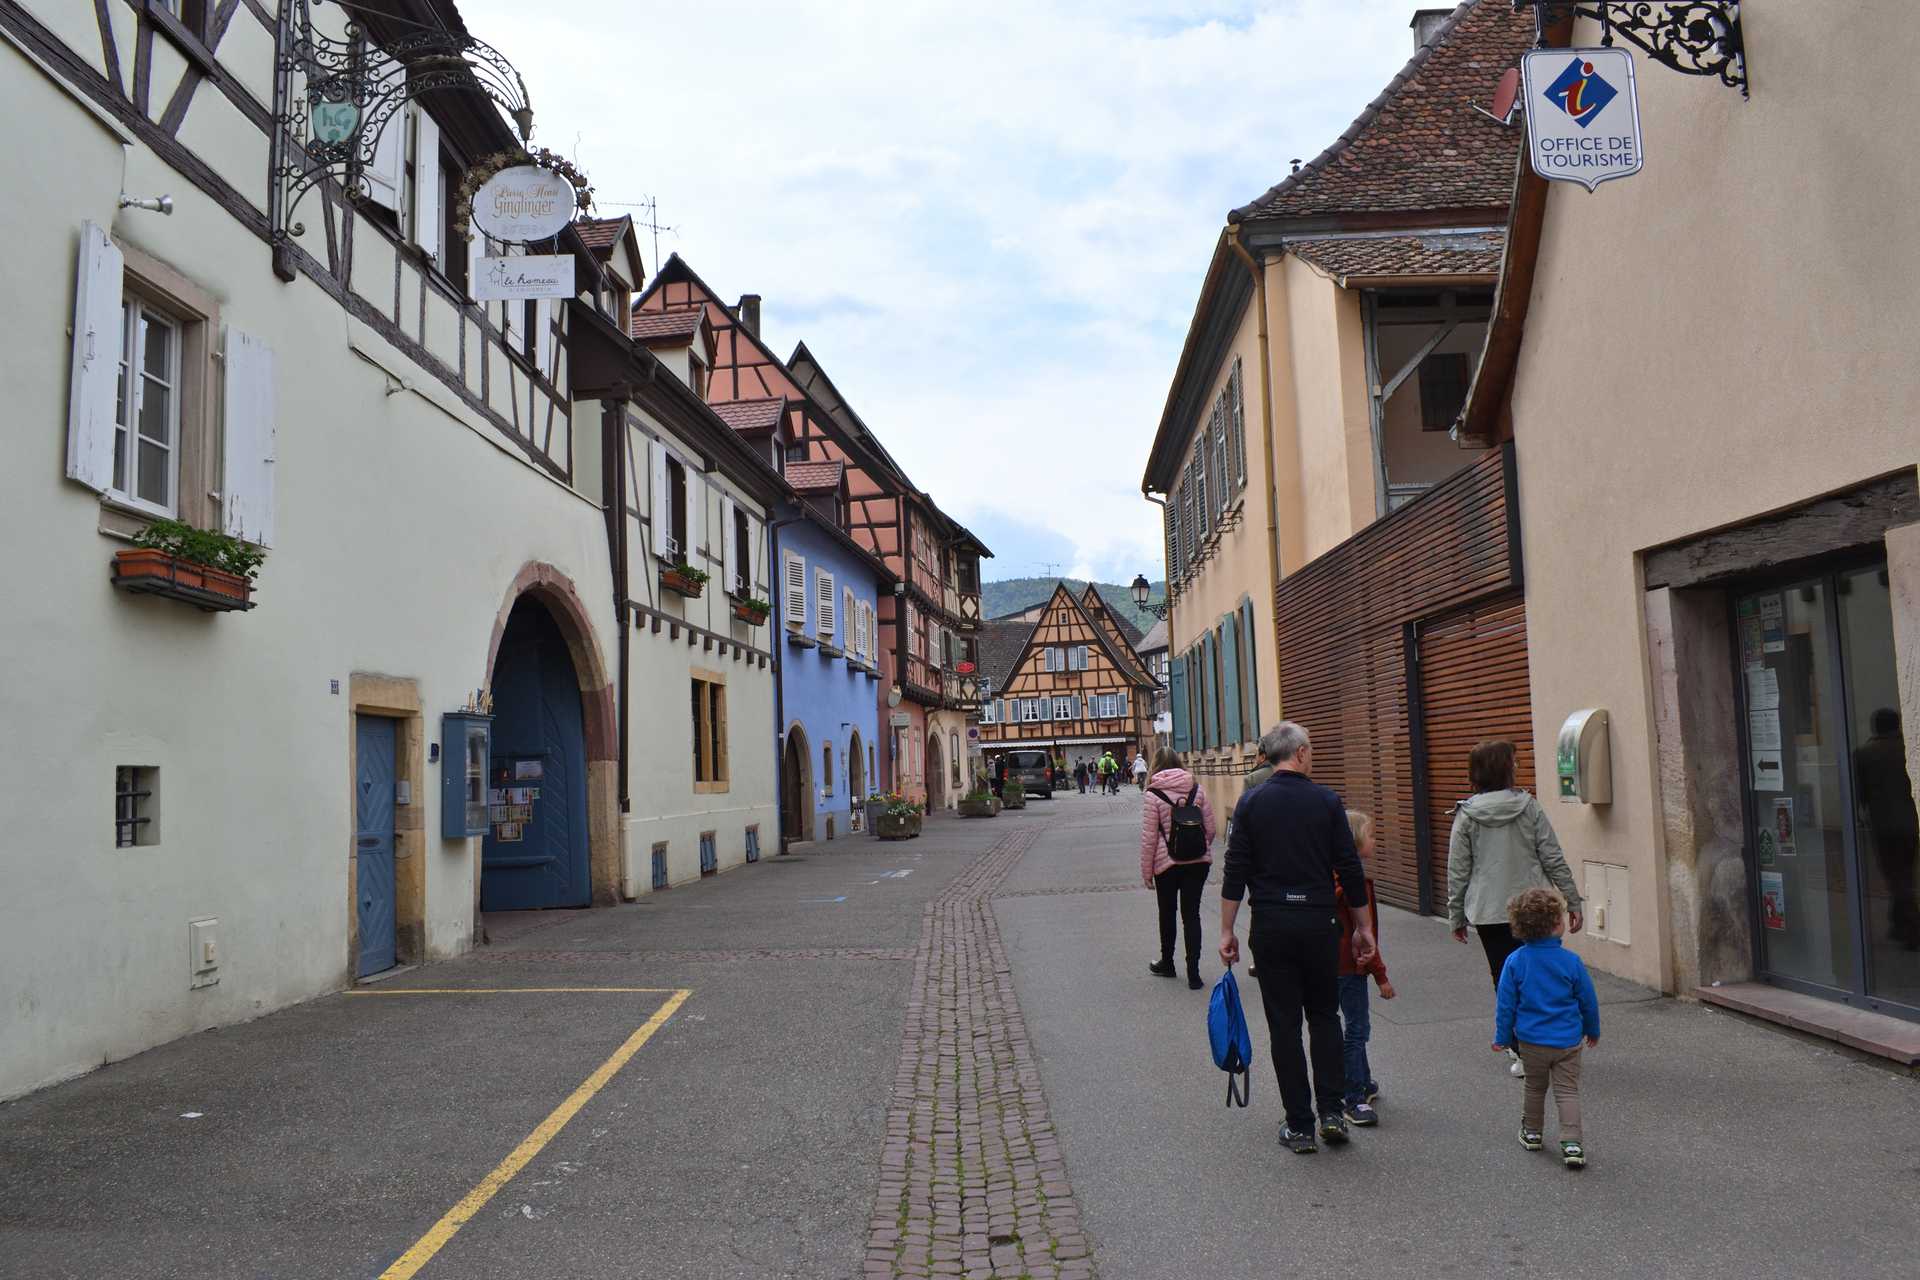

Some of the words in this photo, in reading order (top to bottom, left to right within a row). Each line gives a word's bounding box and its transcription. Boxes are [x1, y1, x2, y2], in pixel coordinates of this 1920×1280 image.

[1540, 137, 1602, 152] OFFICE
[1609, 136, 1633, 150] DE
[1542, 153, 1633, 168] TOURISME
